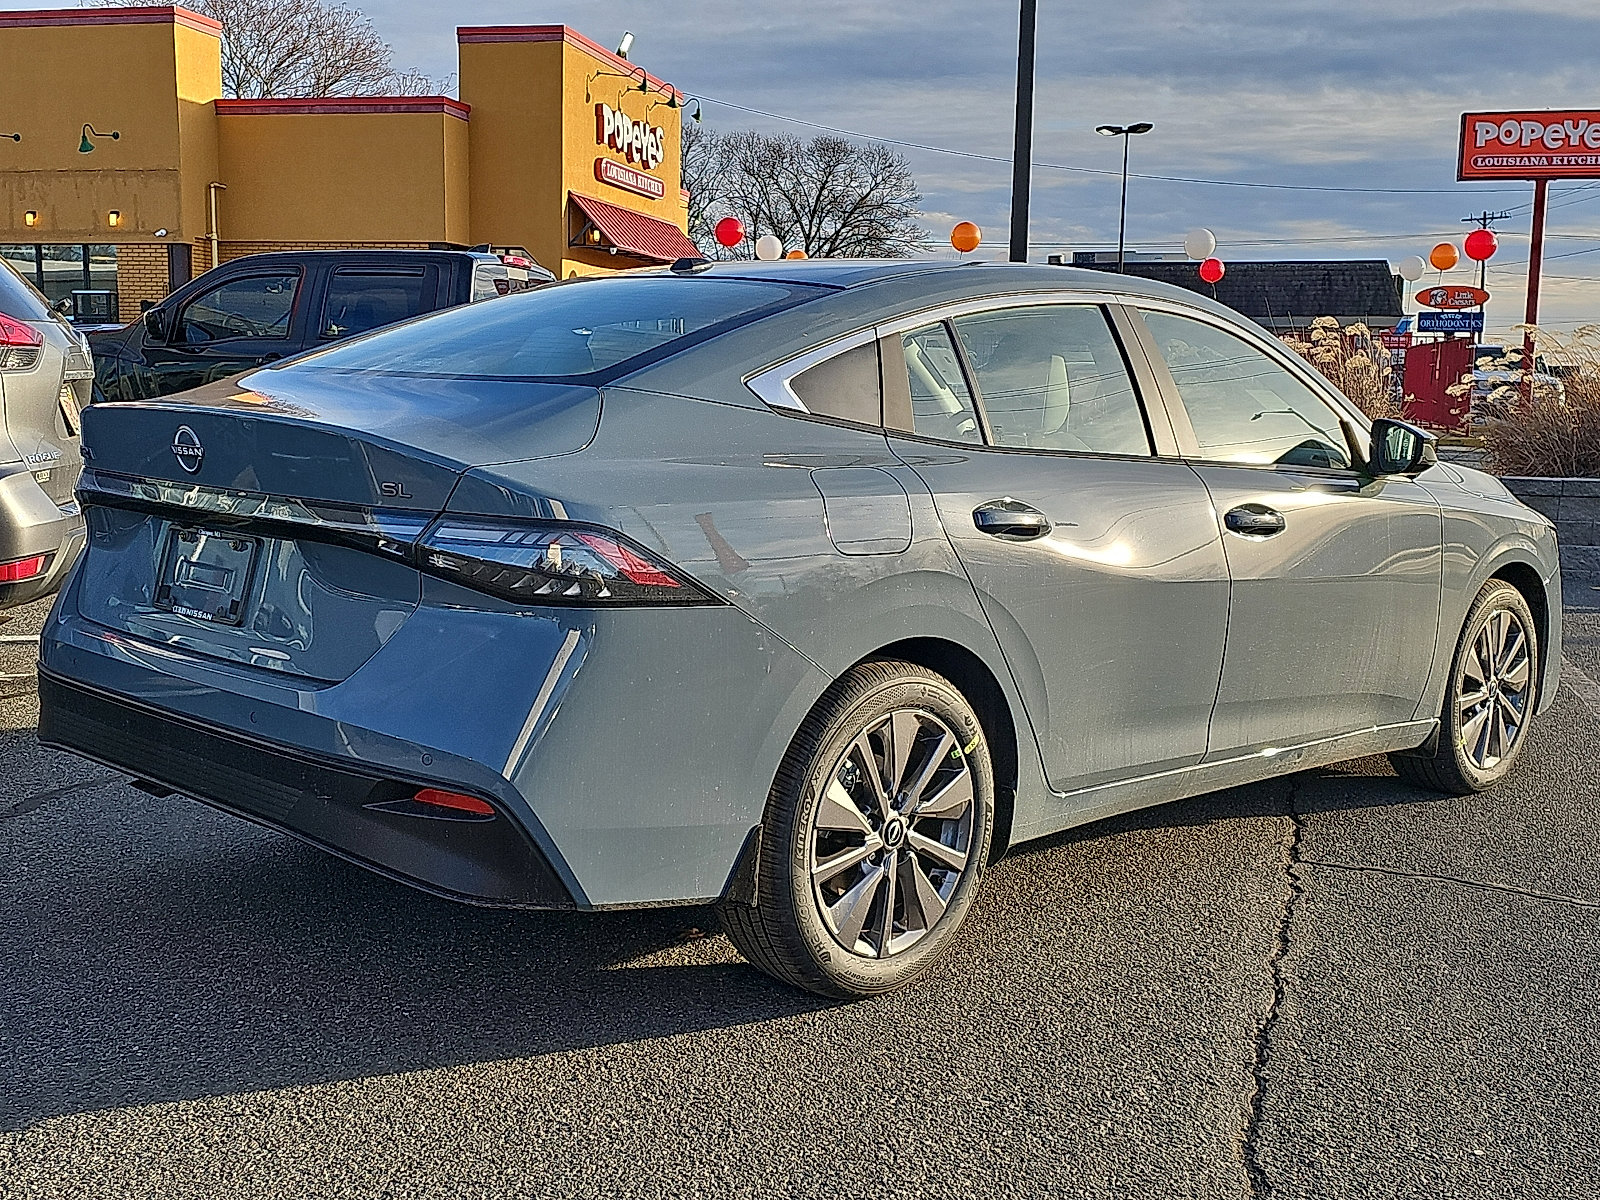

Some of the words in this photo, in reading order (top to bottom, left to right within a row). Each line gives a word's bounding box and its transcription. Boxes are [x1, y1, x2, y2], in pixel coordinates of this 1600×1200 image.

[1476, 156, 1549, 167] LOUISIANA
[605, 162, 638, 187] LOUISIANA
[636, 174, 663, 196] KITCHEN
[1454, 291, 1474, 300] Little
[26, 451, 61, 464] ROGUE
[381, 482, 412, 498] SL
